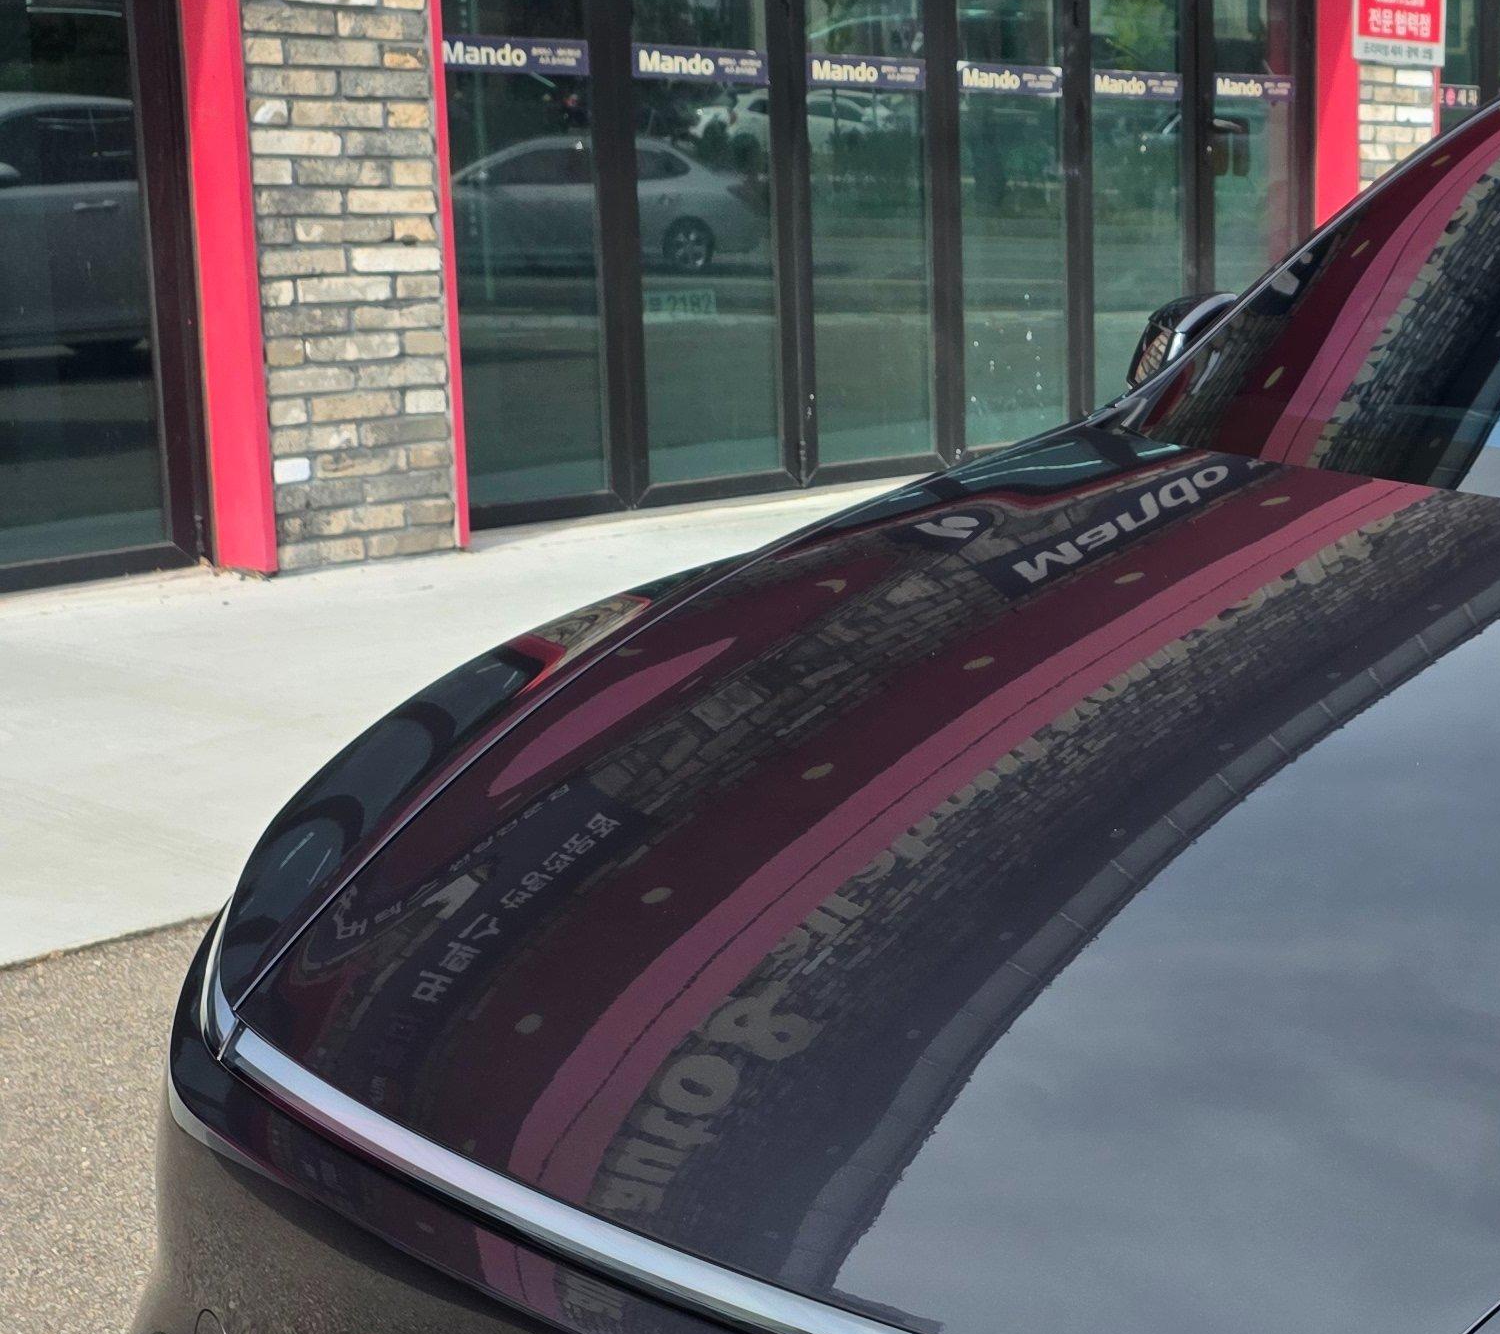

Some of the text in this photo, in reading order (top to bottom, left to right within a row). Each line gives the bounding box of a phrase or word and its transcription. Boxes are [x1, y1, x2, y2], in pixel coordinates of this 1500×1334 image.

[442, 39, 527, 67] Mando
[638, 49, 715, 75] Mando
[811, 58, 879, 84] Mando
[961, 67, 1021, 91] Mando
[1093, 73, 1147, 97] Mando
[1215, 77, 1263, 98] Mando
